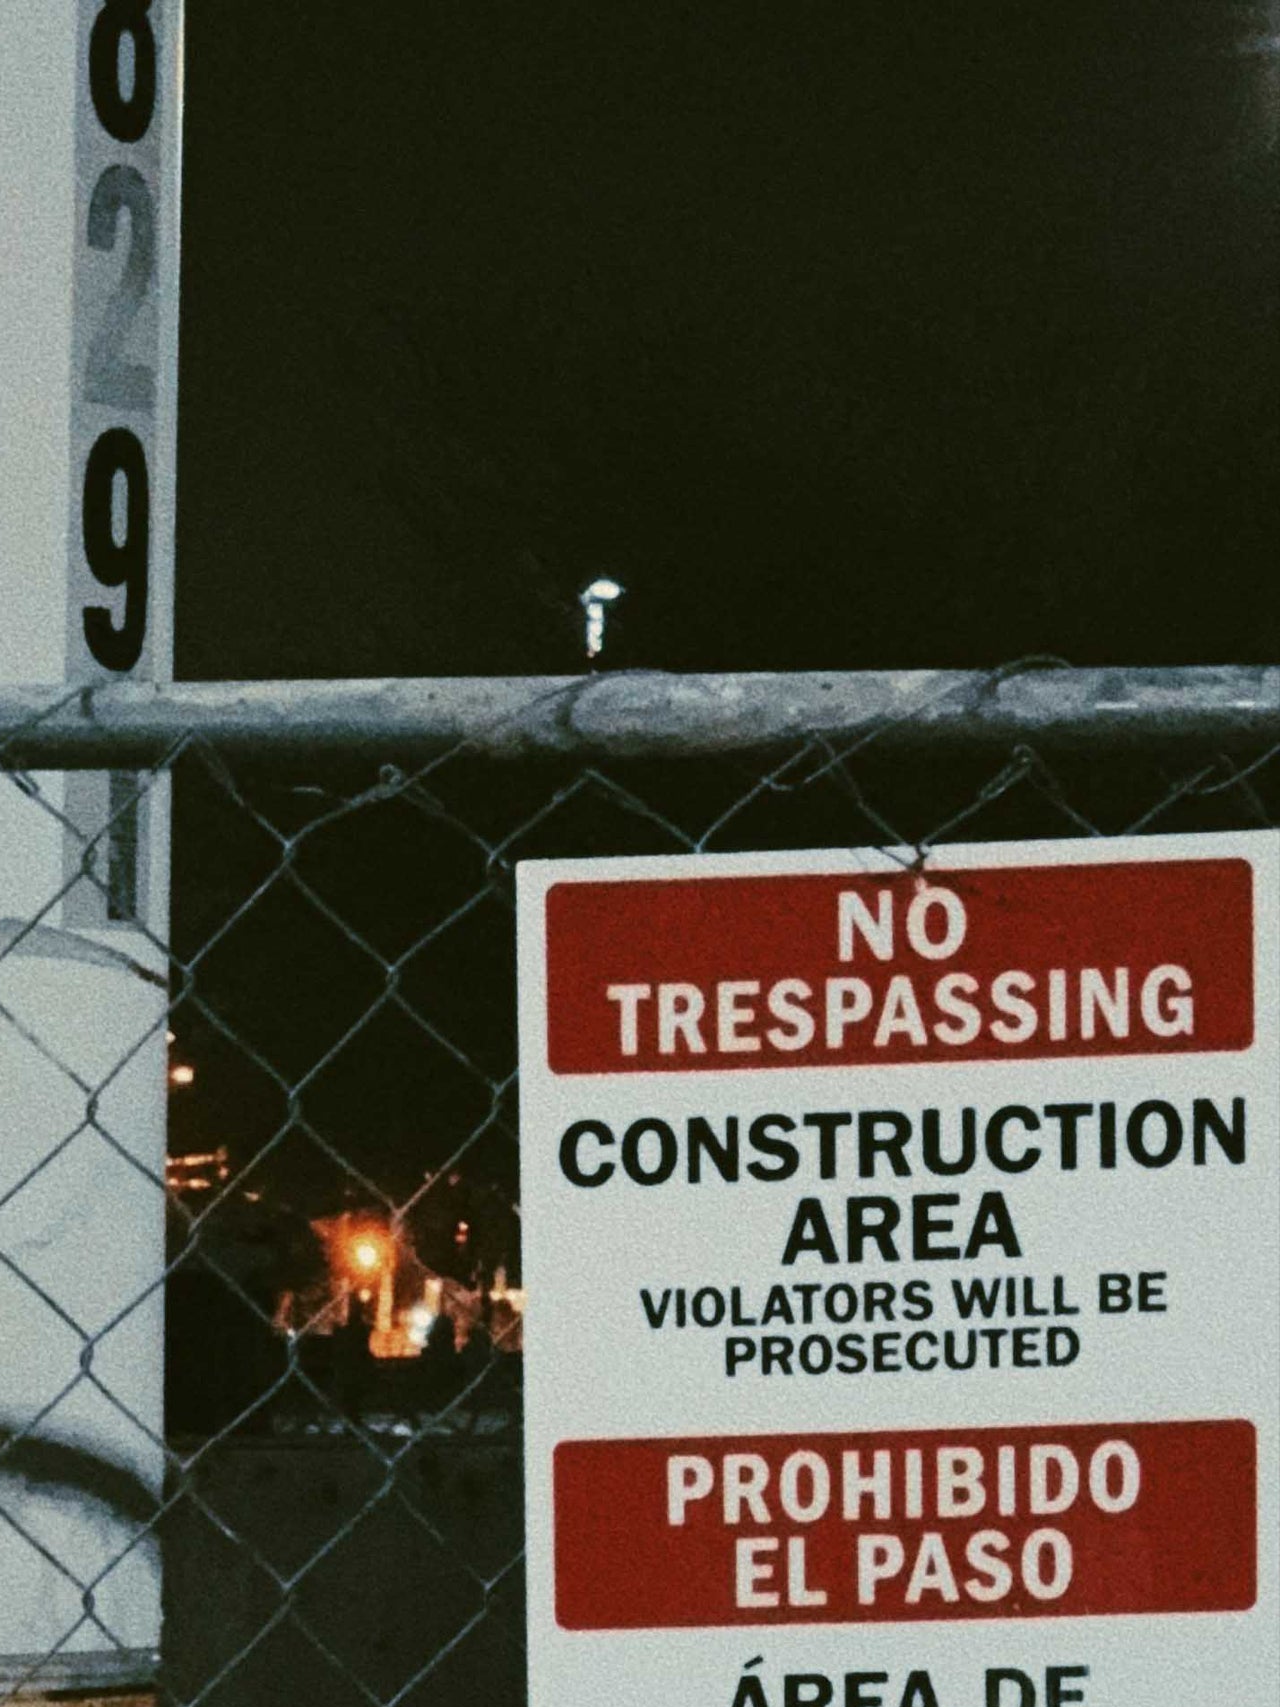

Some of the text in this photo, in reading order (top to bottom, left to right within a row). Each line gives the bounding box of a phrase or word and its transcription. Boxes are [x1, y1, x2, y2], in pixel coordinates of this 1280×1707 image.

[838, 887, 966, 961] NO
[607, 965, 1195, 1056] TRESPASSING
[559, 1097, 1246, 1188] CONSTRUCTION
[781, 1191, 1022, 1265] AREA
[640, 1271, 1167, 1329] VIOLATORS WILL BE
[725, 1326, 1080, 1377] PROSECUTED
[667, 1440, 1140, 1525] PROHIBIDO
[736, 1528, 1072, 1608] EL PASO
